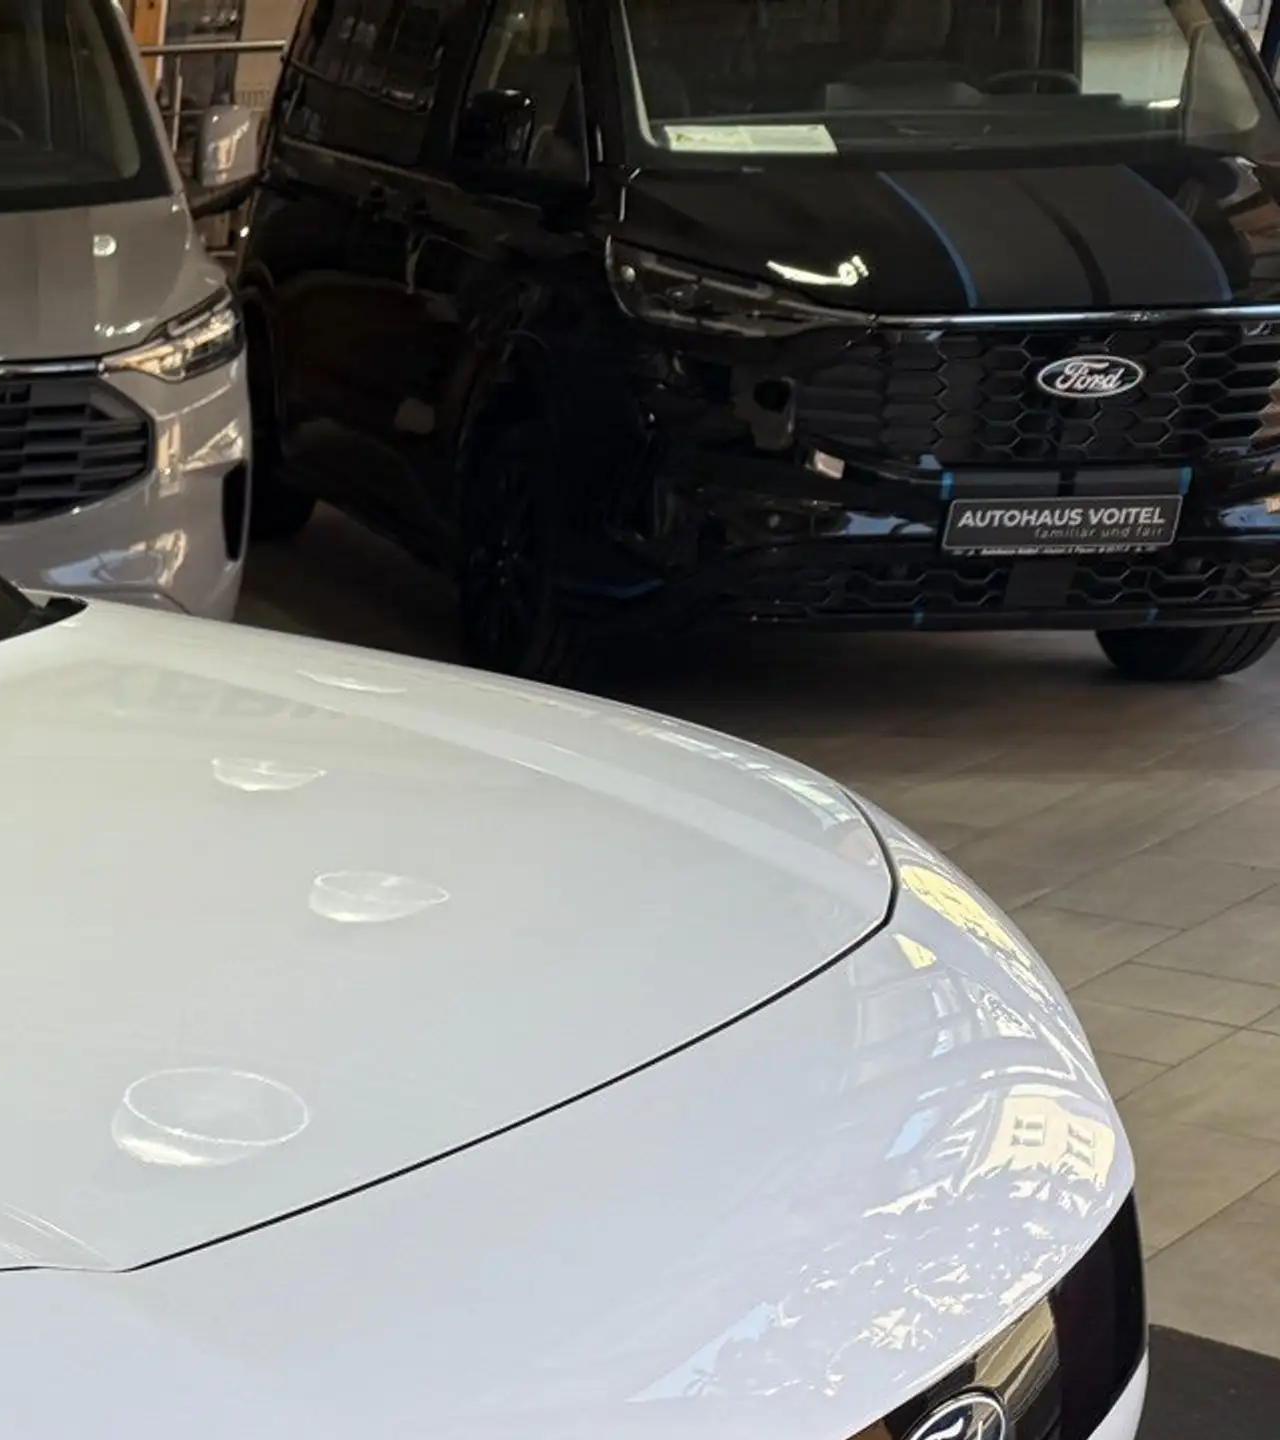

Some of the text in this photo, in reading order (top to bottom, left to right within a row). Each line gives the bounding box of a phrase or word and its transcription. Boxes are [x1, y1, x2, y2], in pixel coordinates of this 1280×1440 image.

[1056, 362, 1126, 391] Ford
[957, 506, 1166, 528] AUTOHAUS VOITEL
[1101, 526, 1131, 538] und
